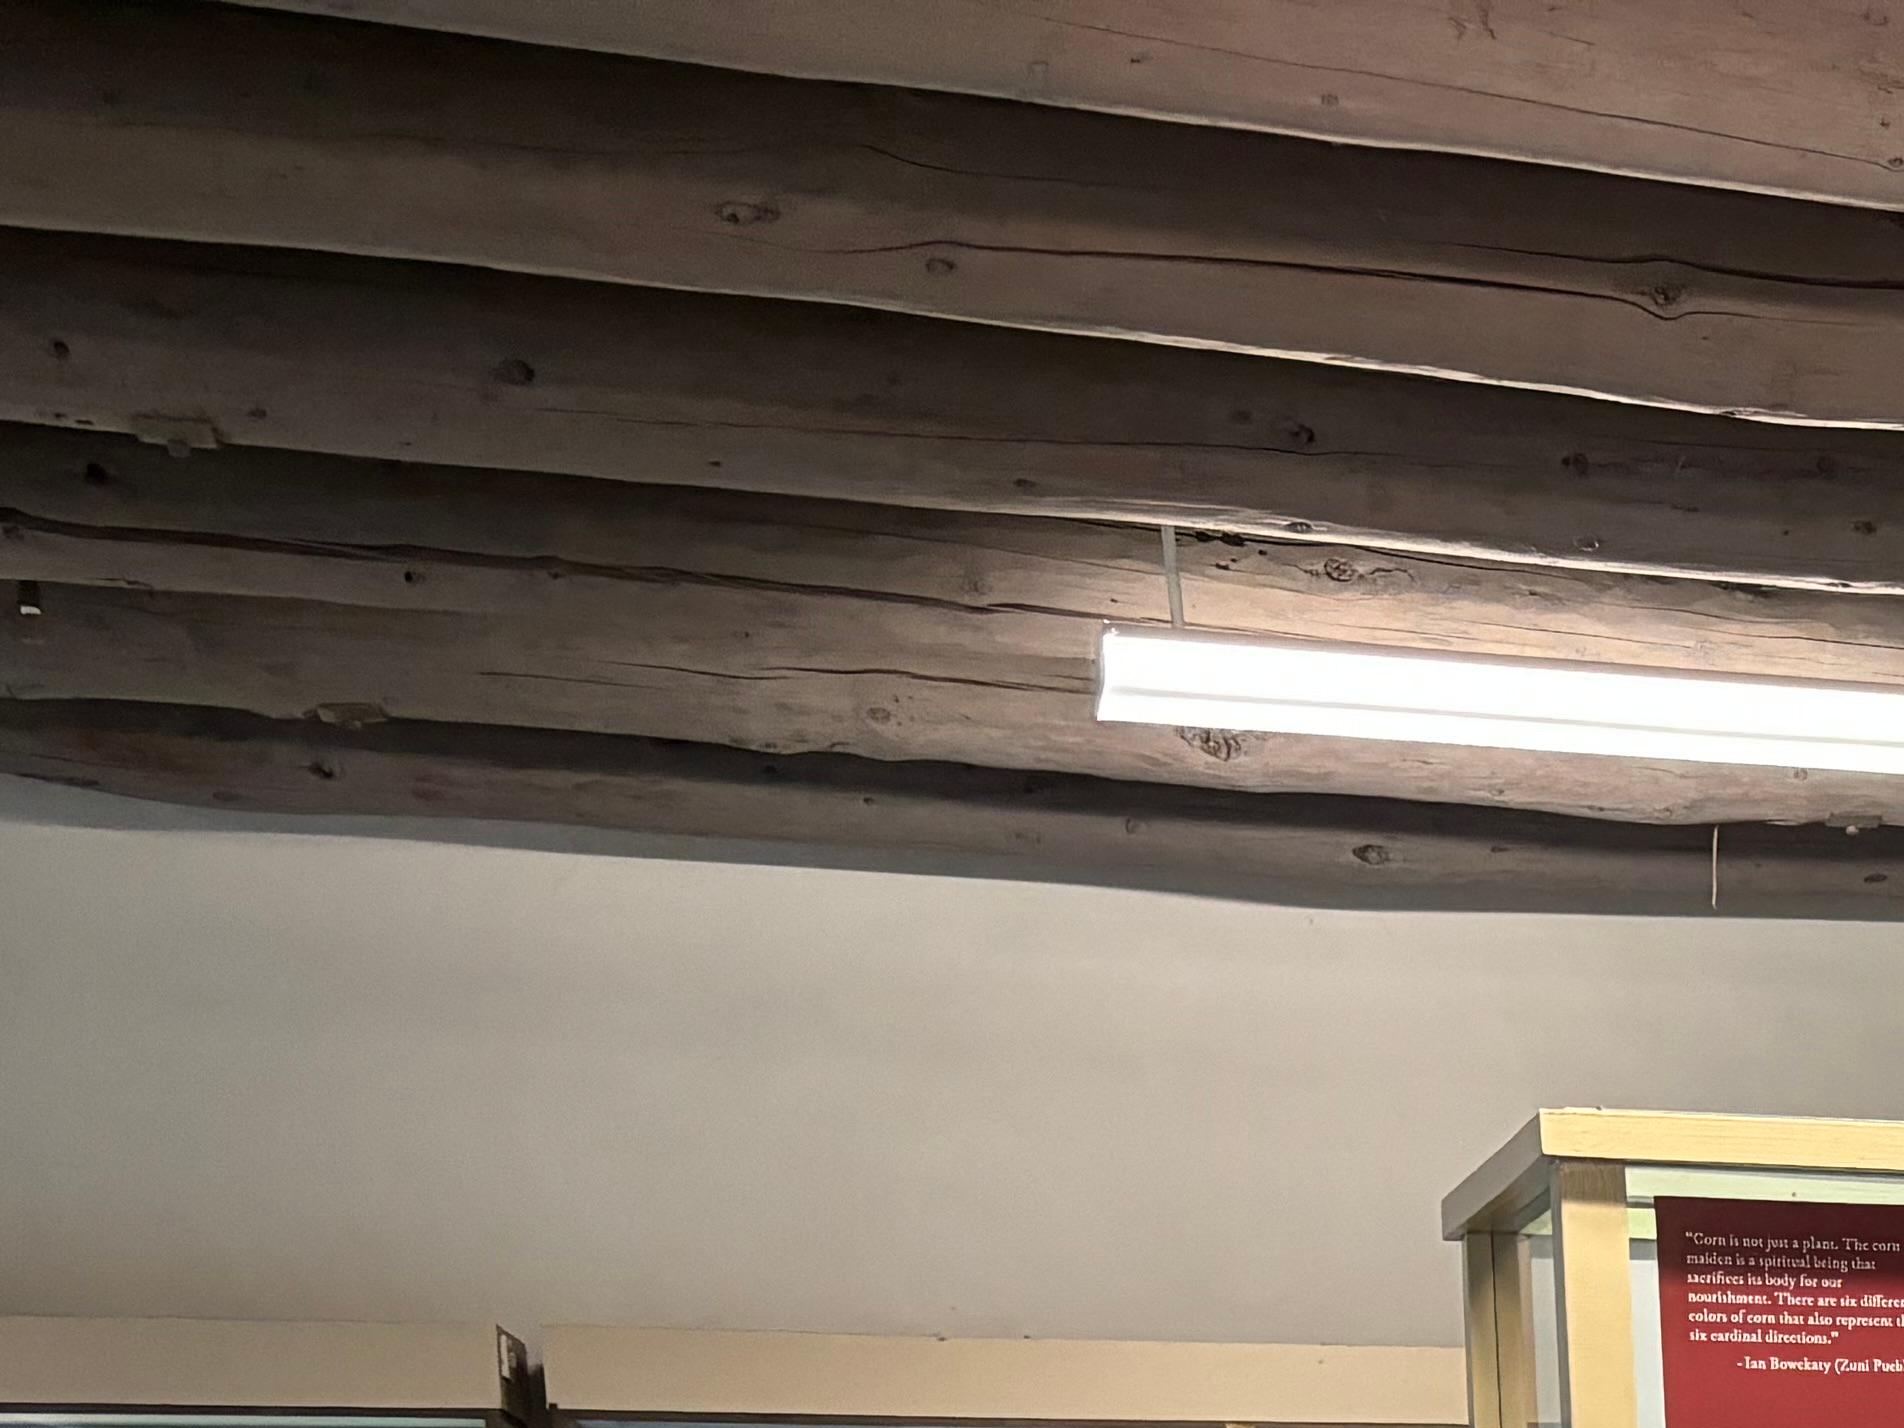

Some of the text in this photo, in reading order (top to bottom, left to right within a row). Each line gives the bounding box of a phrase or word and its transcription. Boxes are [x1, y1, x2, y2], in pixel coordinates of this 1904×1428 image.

[1729, 1235, 1738, 1246] is
[1743, 1237, 1763, 1247] not
[1767, 1237, 1789, 1252] just
[1803, 1237, 1838, 1252] plant.
[1842, 1238, 1869, 1251] The
[1873, 1243, 1900, 1252] corn
[1687, 1255, 1732, 1265] maiden
[1737, 1254, 1745, 1265] is
[1760, 1255, 1810, 1270] spiritual
[1814, 1256, 1848, 1272] being
[1851, 1257, 1876, 1269] that
[1687, 1272, 1843, 1288] sacrifices its body for our
[1688, 1292, 1772, 1305] nourishment.
[1774, 1293, 1814, 1306] There
[1818, 1298, 1836, 1306] are
[1840, 1295, 1857, 1307] six
[1688, 1309, 1727, 1322] colors
[1730, 1310, 1746, 1322] of
[1747, 1314, 1775, 1324] corn
[1779, 1312, 1804, 1325] that
[1808, 1312, 1832, 1325] also
[1836, 1316, 1893, 1330] represent
[1689, 1329, 1707, 1341] six
[1710, 1330, 1762, 1343] cardinal
[1835, 1358, 1869, 1374] (Zuni
